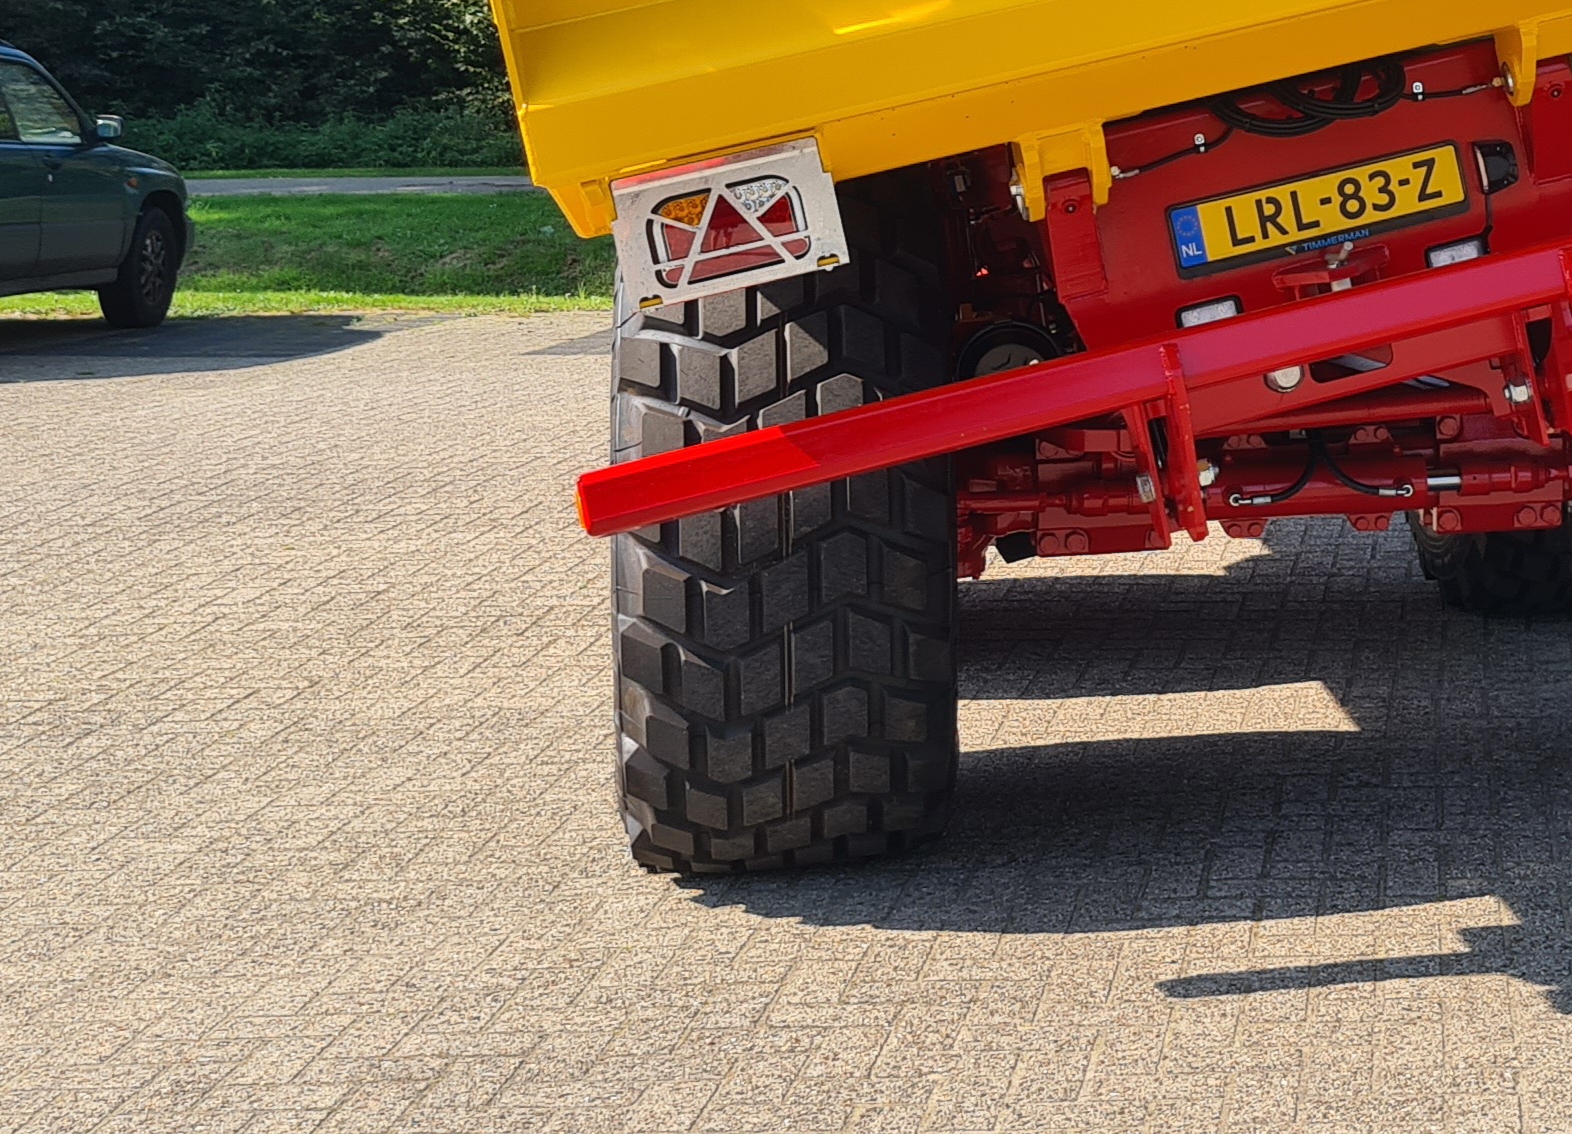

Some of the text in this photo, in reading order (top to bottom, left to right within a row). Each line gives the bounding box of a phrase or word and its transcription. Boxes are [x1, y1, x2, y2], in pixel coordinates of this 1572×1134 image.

[1224, 156, 1443, 248] LRL-83-Z
[1181, 244, 1203, 258] NL
[1302, 228, 1370, 252] TIMMERMAN
